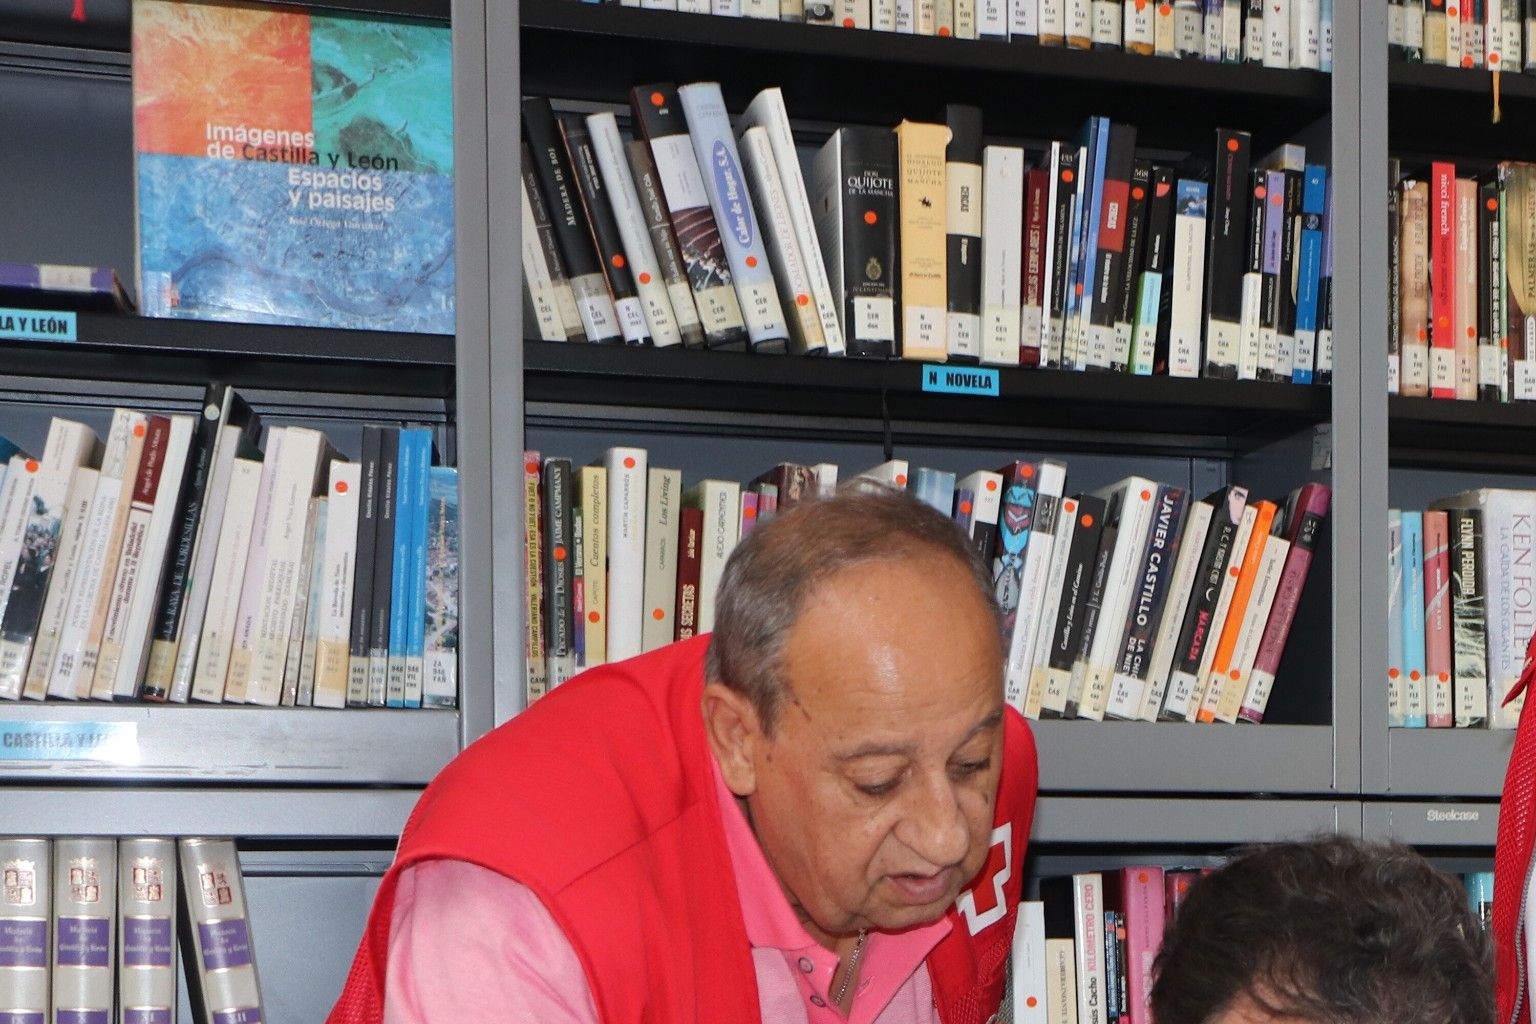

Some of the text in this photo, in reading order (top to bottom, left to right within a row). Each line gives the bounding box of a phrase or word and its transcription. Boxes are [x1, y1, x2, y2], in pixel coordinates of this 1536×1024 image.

[206, 123, 314, 149] Imágenes
[206, 144, 399, 171] de Castilla y León
[288, 168, 383, 192] Espacios
[552, 167, 563, 181] DE
[847, 176, 894, 190] QUIJOTE
[1438, 173, 1450, 199] nicci
[287, 190, 395, 214] y paisajes
[556, 184, 577, 227] MADERA
[729, 200, 743, 215] de
[732, 214, 750, 245] Calor
[1439, 200, 1450, 235] french
[1526, 242, 1536, 297] PALMERAS
[18, 318, 27, 333] Y
[31, 316, 67, 335] LEÓN
[929, 371, 992, 389] N NOVELA
[552, 466, 563, 543] JAIME CAMPMANY
[589, 474, 601, 524] completos
[175, 501, 197, 568] TORDESILLAS
[589, 527, 599, 566] Cuentos
[1512, 513, 1531, 566] KEN
[1135, 494, 1174, 627] JAVIER CASTILLO
[1461, 517, 1475, 596] FLYNN PERDIDA
[171, 571, 184, 586] DE
[162, 617, 174, 634] LA
[1186, 608, 1210, 662] MARCADA
[1126, 636, 1137, 651] DE
[1135, 638, 1145, 652] LA
[1427, 809, 1479, 822] Steelcase
[1083, 883, 1094, 910] CERO
[1089, 976, 1098, 1004] Cacho
